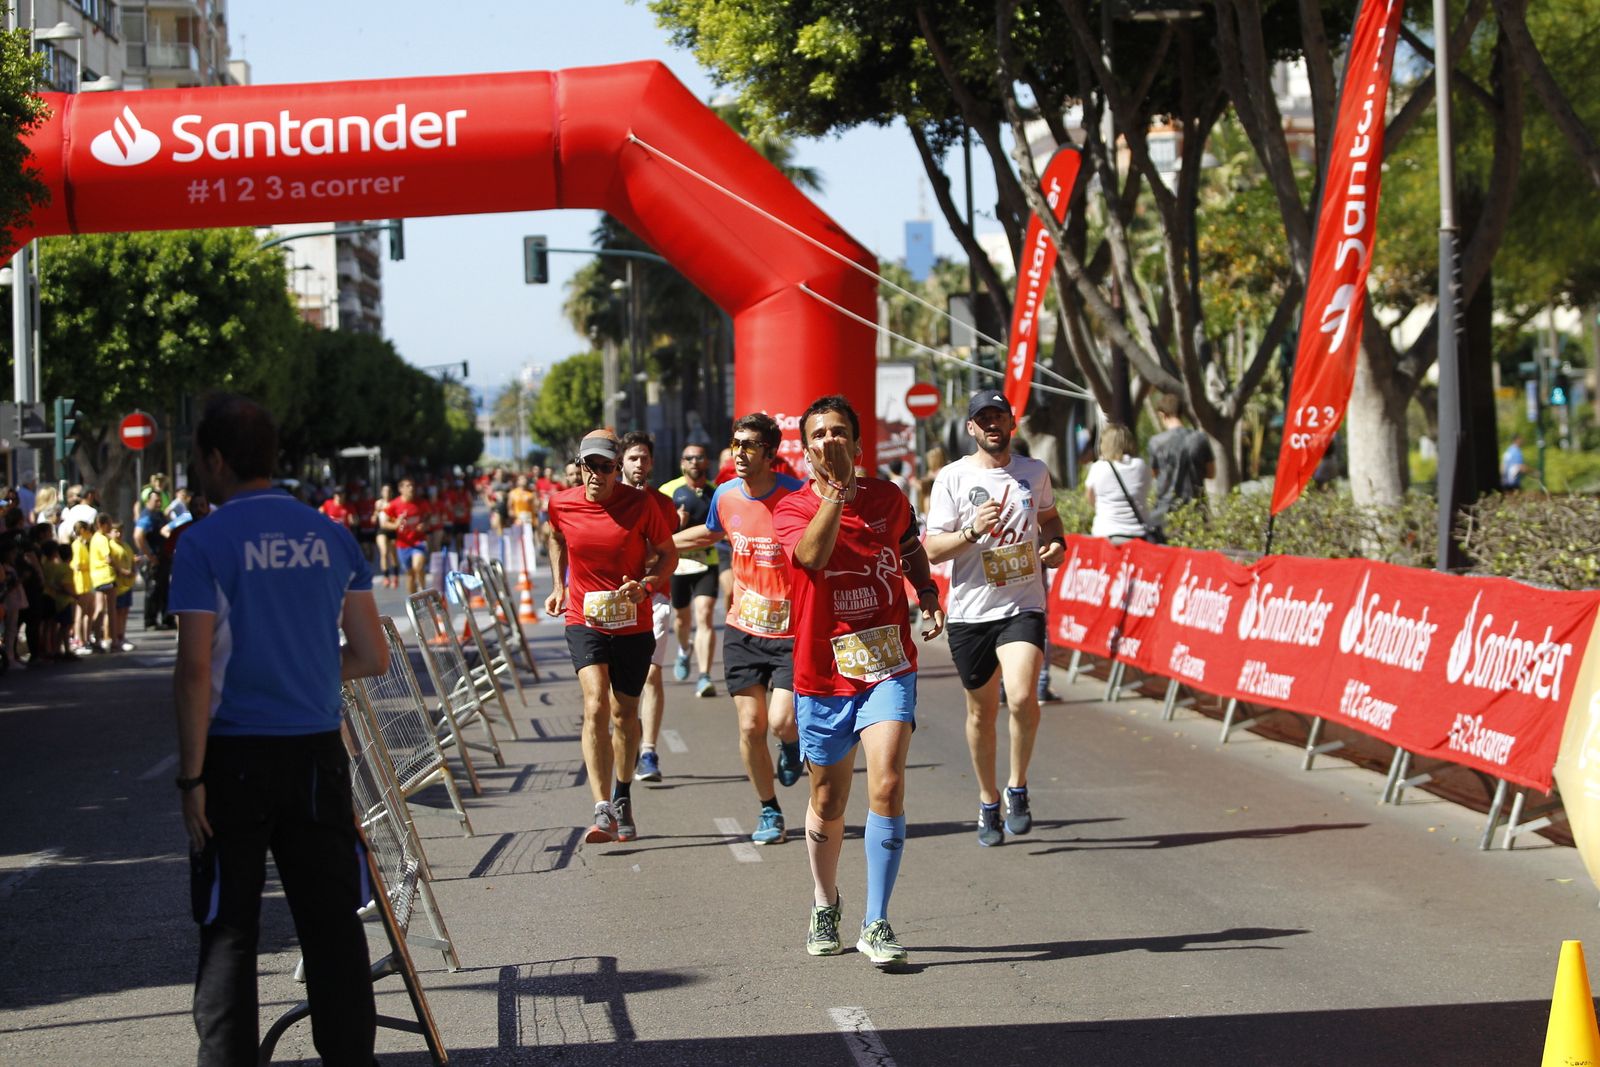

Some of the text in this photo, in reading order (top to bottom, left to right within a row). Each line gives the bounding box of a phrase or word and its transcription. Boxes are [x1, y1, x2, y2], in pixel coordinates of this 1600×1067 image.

[171, 103, 468, 163] Santander
[310, 175, 405, 198] correr
[989, 554, 1029, 575] 3108
[833, 586, 877, 600] CARRERA
[833, 597, 879, 611] SOLIDARIA
[589, 602, 628, 617] 3115
[1250, 582, 1334, 647] Santander
[1353, 593, 1438, 672] Santander
[842, 642, 893, 668] 3031
[1463, 613, 1572, 701] Santander
